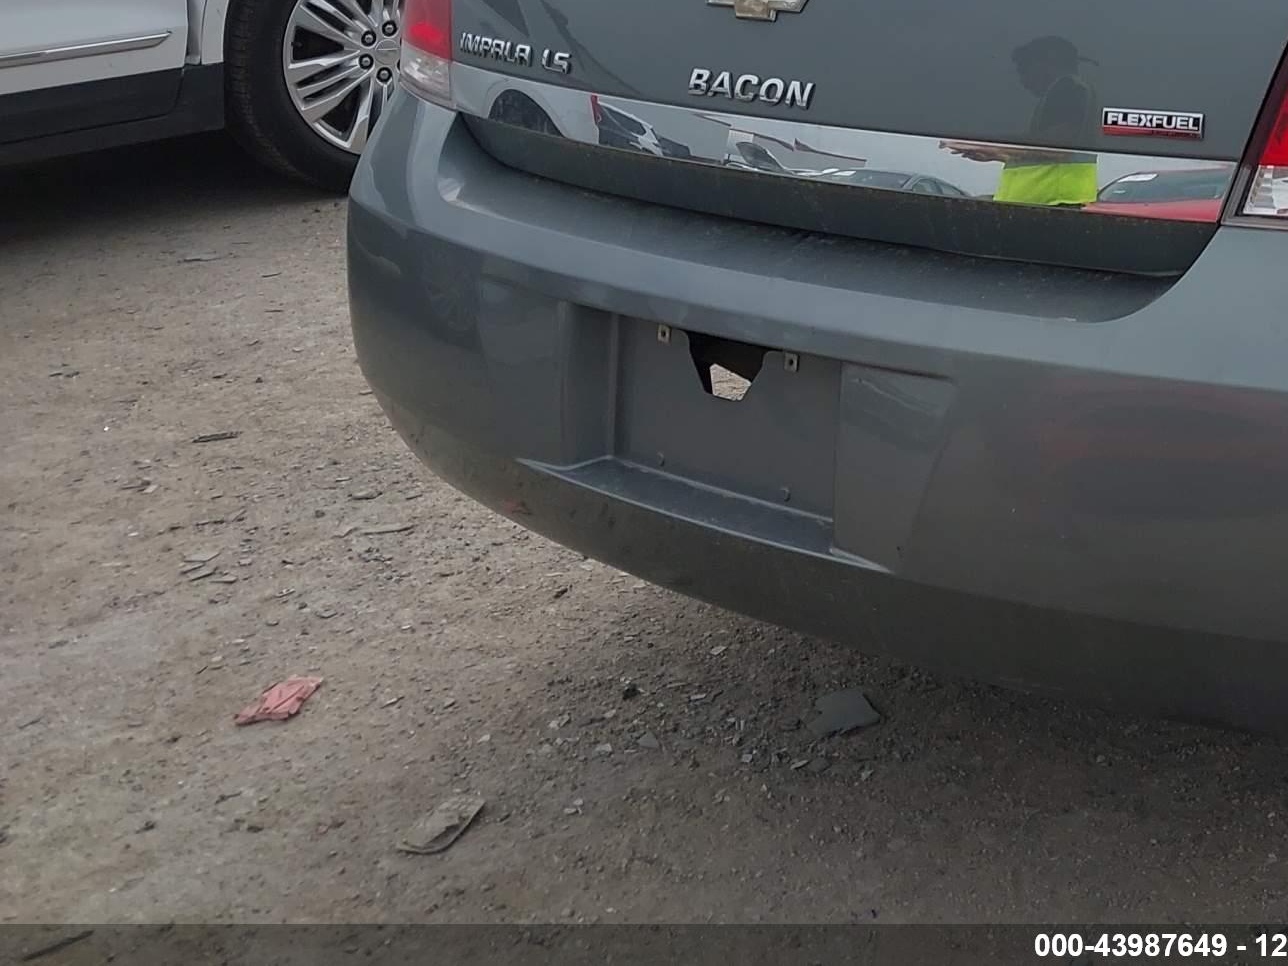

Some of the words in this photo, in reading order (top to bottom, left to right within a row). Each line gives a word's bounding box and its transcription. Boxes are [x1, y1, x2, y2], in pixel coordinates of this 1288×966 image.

[460, 32, 532, 67] IMPALA
[541, 49, 571, 74] LS
[688, 67, 815, 109] BACON
[1106, 112, 1199, 131] FLEXFUEL
